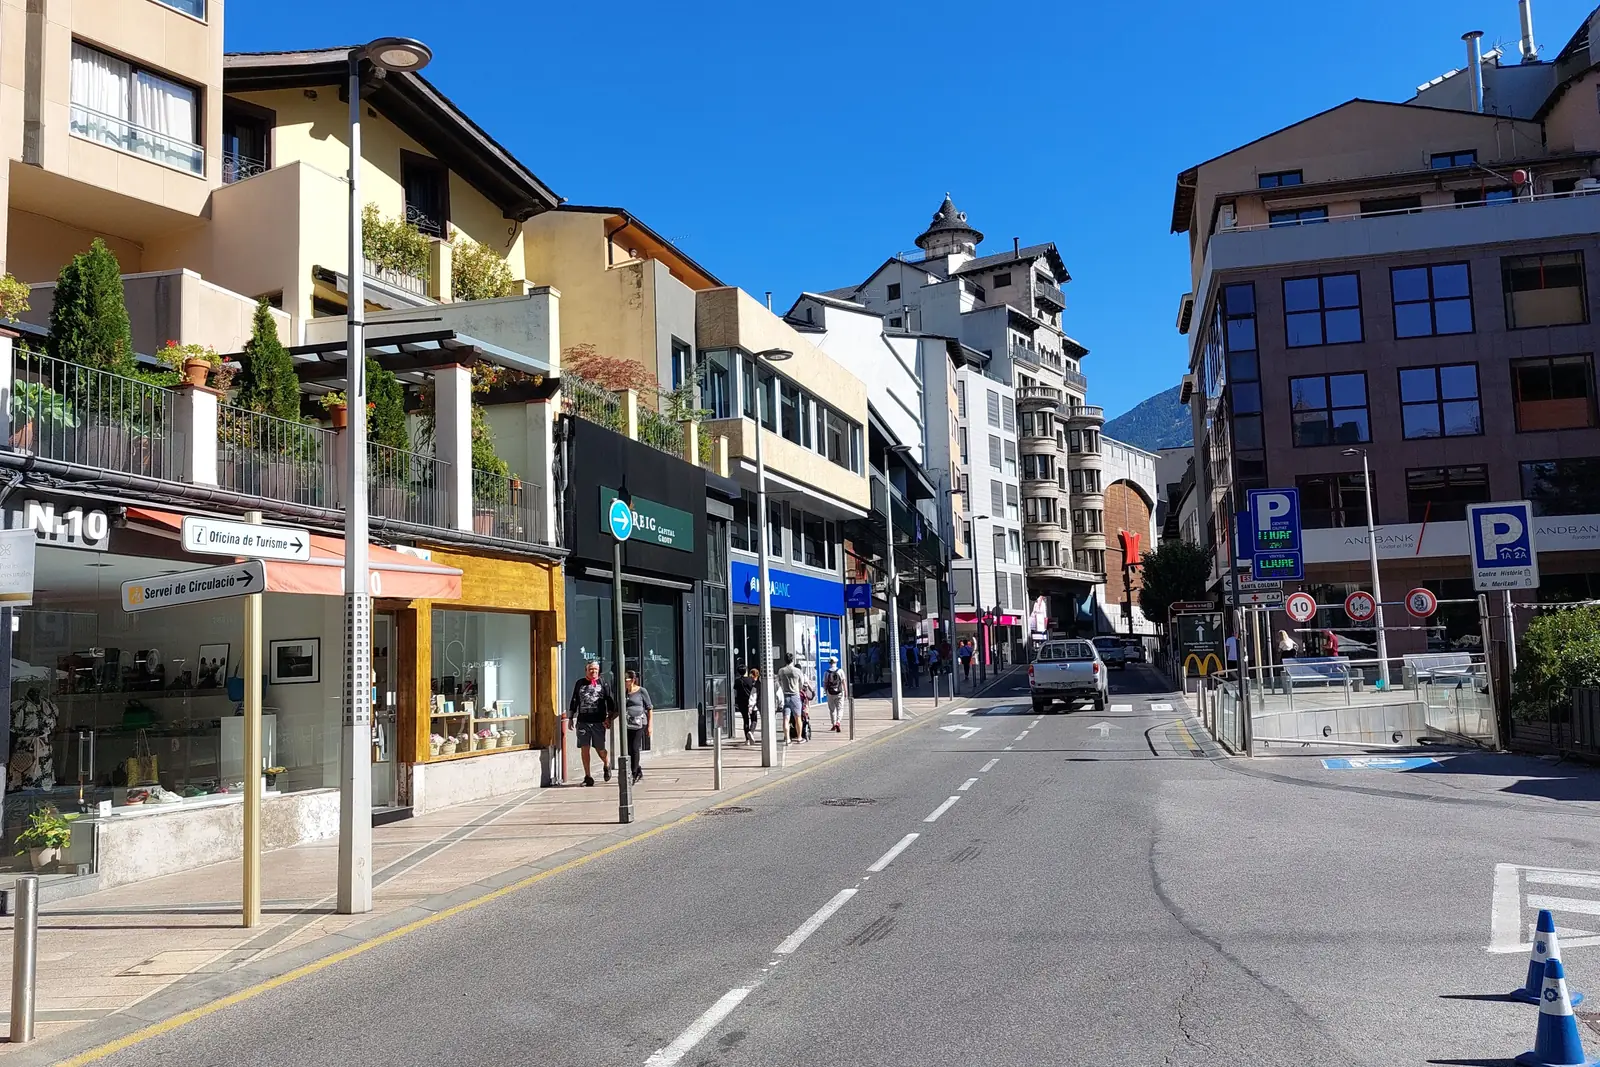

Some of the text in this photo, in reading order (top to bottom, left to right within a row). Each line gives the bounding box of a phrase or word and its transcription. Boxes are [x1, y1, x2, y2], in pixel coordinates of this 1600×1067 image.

[25, 501, 108, 540] N.10
[631, 511, 656, 530] REIG
[1256, 494, 1291, 531] P
[209, 530, 240, 545] Oficina
[243, 534, 253, 546] de
[256, 536, 288, 550] Turisme
[1480, 513, 1523, 560] P
[1536, 525, 1599, 535] ANDBAN
[1514, 551, 1527, 559] 2A
[144, 575, 235, 599] Servei de Circulació
[1292, 602, 1308, 612] 10
